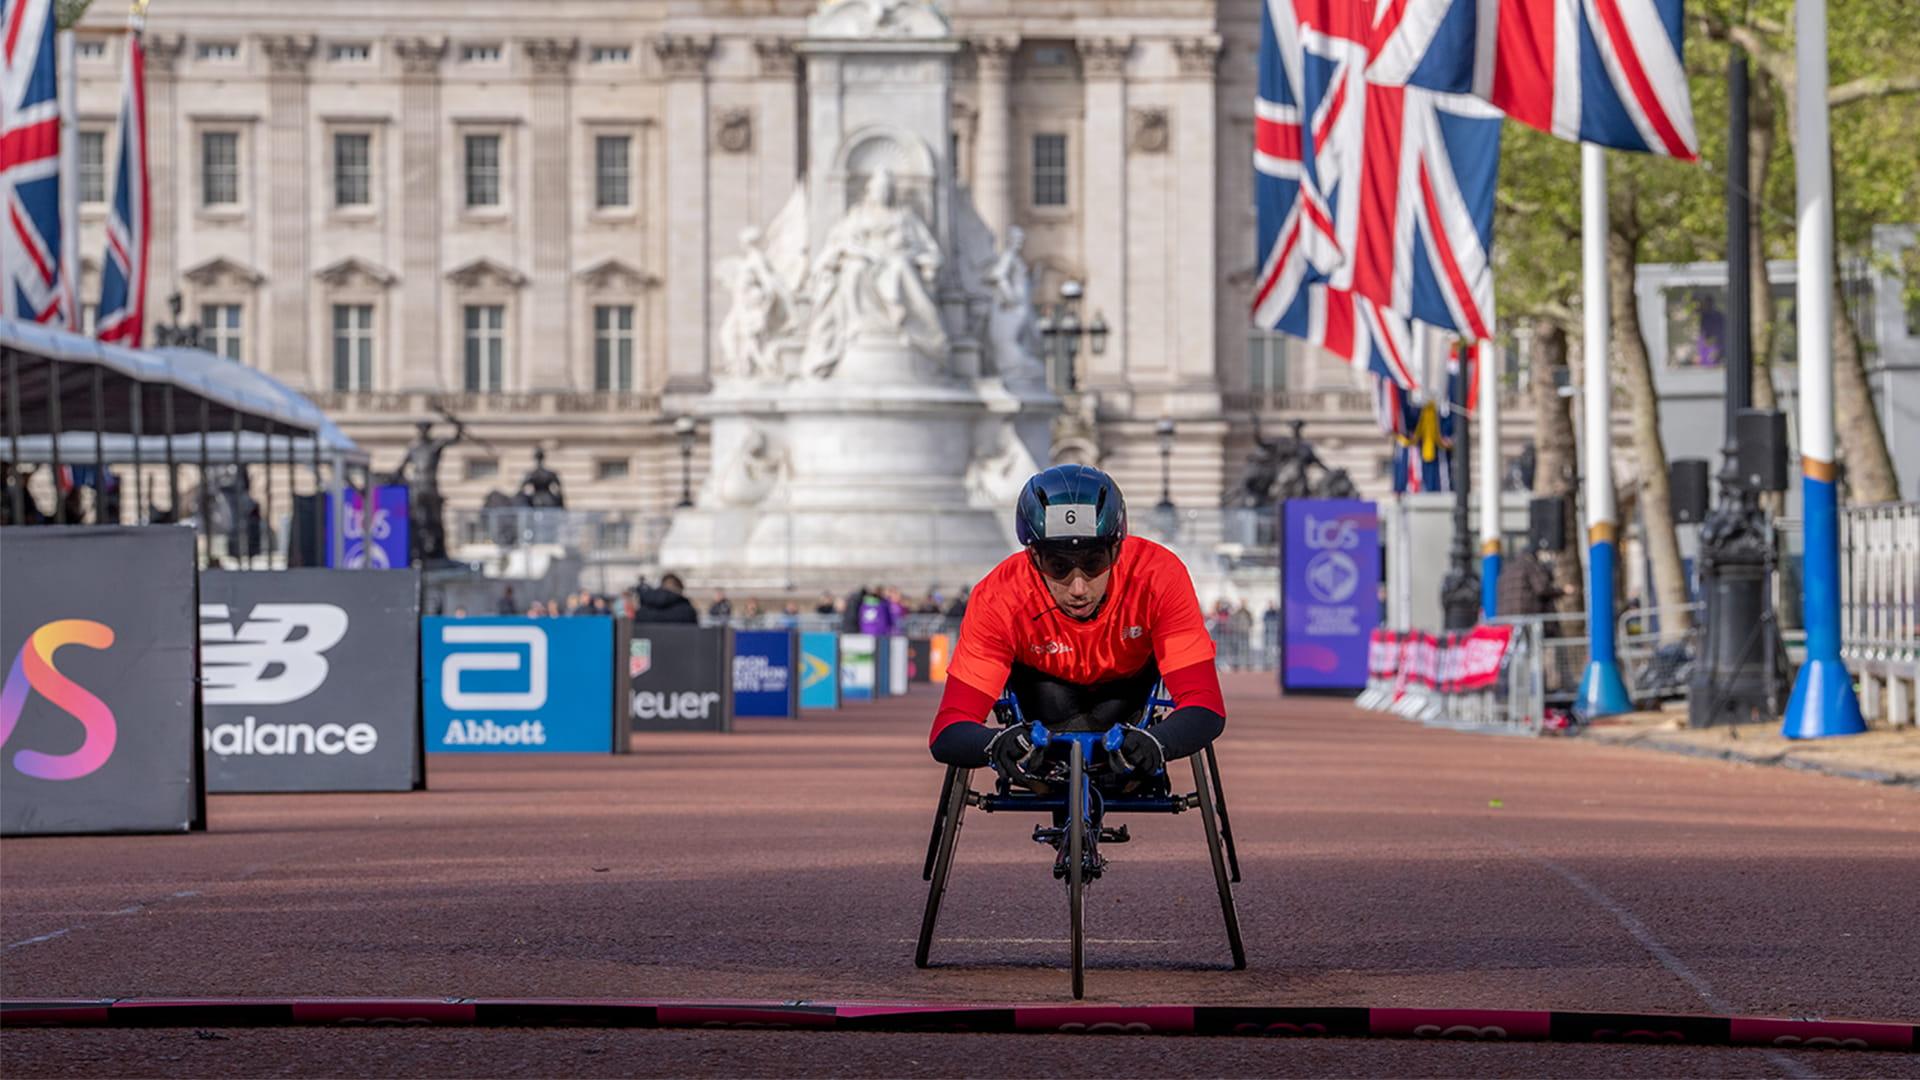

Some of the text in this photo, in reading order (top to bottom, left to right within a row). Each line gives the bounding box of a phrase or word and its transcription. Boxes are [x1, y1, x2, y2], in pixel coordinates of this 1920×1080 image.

[1065, 510, 1076, 524] 6
[1305, 514, 1359, 549] tcs
[203, 717, 378, 755] alance
[443, 720, 546, 745] Abbott
